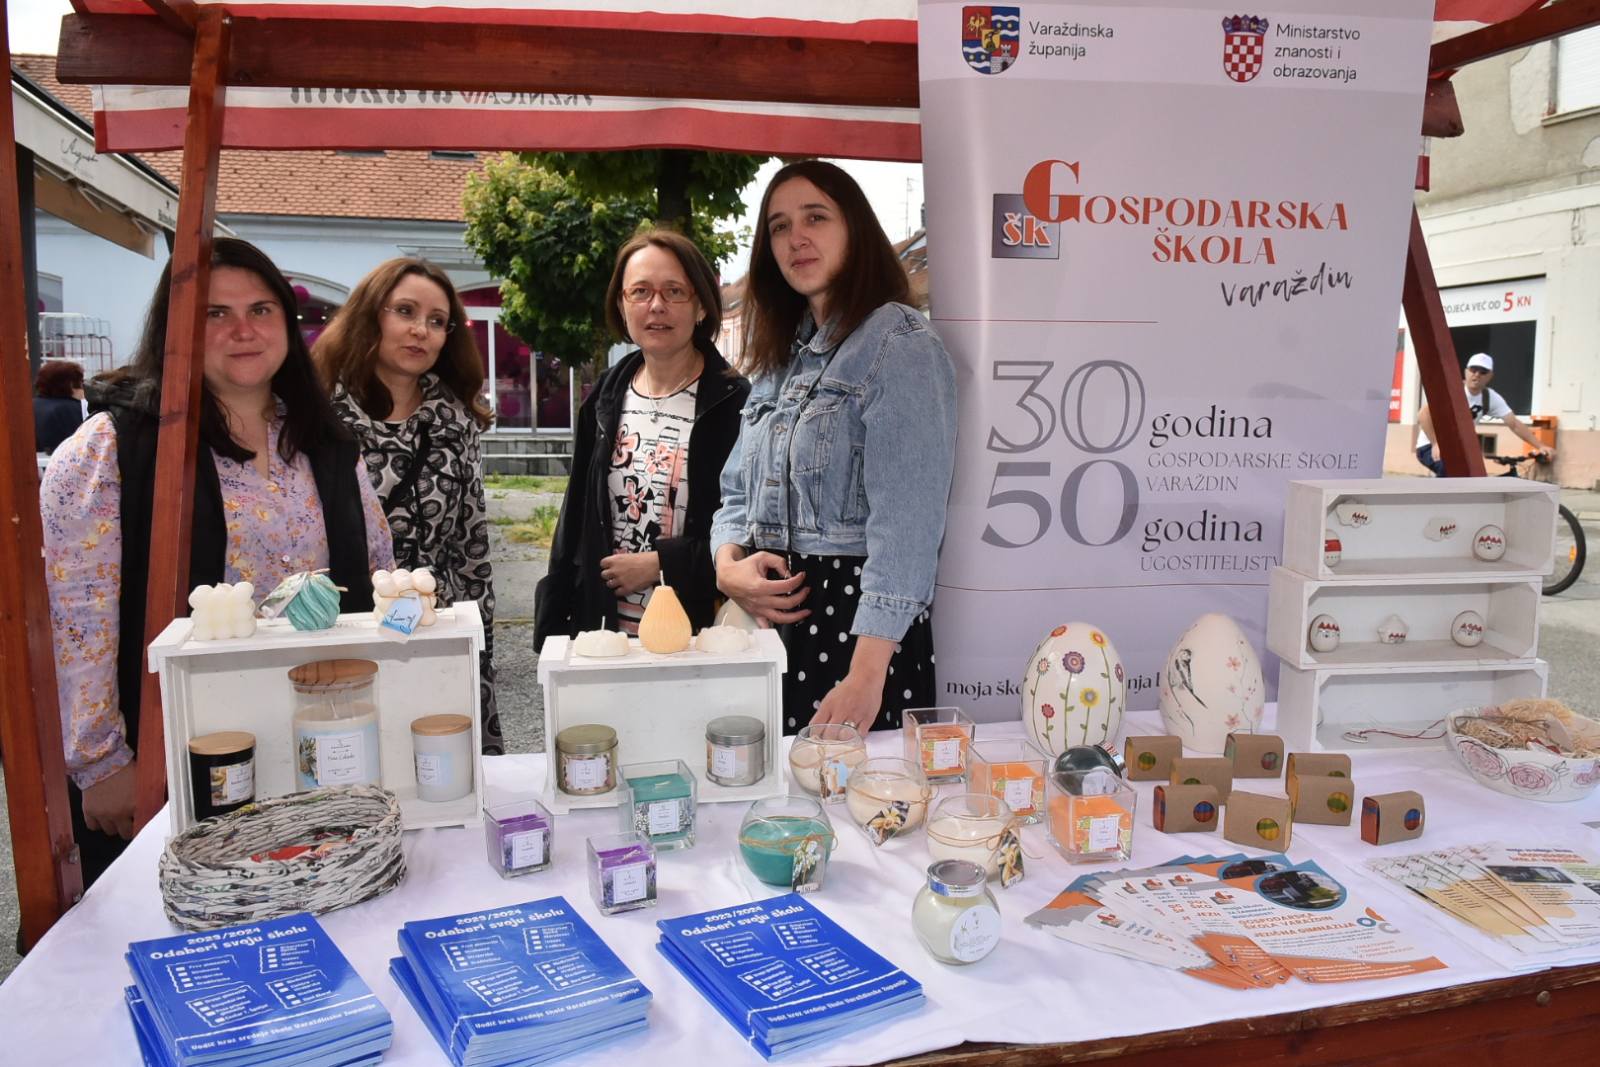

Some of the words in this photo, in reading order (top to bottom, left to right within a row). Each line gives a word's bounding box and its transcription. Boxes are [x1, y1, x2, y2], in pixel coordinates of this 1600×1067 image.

[1028, 21, 1114, 38] Varaždinska
[1276, 23, 1361, 40] Ministarstvo
[1028, 41, 1086, 61] županija
[1274, 45, 1333, 59] znanosti
[1273, 64, 1357, 83] obrazovanja
[1022, 159, 1349, 231] GOSPODARSKA
[1152, 227, 1277, 265] ŠKOLA
[1488, 299, 1502, 310] OD
[1503, 292, 1514, 312] 5
[1517, 296, 1532, 307] KN
[986, 360, 1146, 454] 30
[1149, 405, 1273, 449] godina
[1147, 452, 1292, 470] GOSPODARSKE
[1297, 450, 1359, 470] ŠKOLE
[1146, 473, 1239, 493] VARAŽDIN
[981, 459, 1140, 549] 50
[1141, 509, 1264, 553] godina
[946, 681, 992, 701] moja
[424, 923, 486, 939] Odaberi
[488, 917, 525, 929] svoju
[528, 909, 565, 921] školu
[455, 908, 522, 925] 2023/2024
[681, 920, 736, 937] Odaberi
[737, 914, 770, 926] svoju
[771, 905, 804, 918] školu
[704, 906, 764, 923] 2023/2024
[150, 942, 219, 960] Odaberi
[222, 935, 264, 949] svoju
[268, 926, 308, 940] školu
[187, 926, 261, 946] 2023/2024
